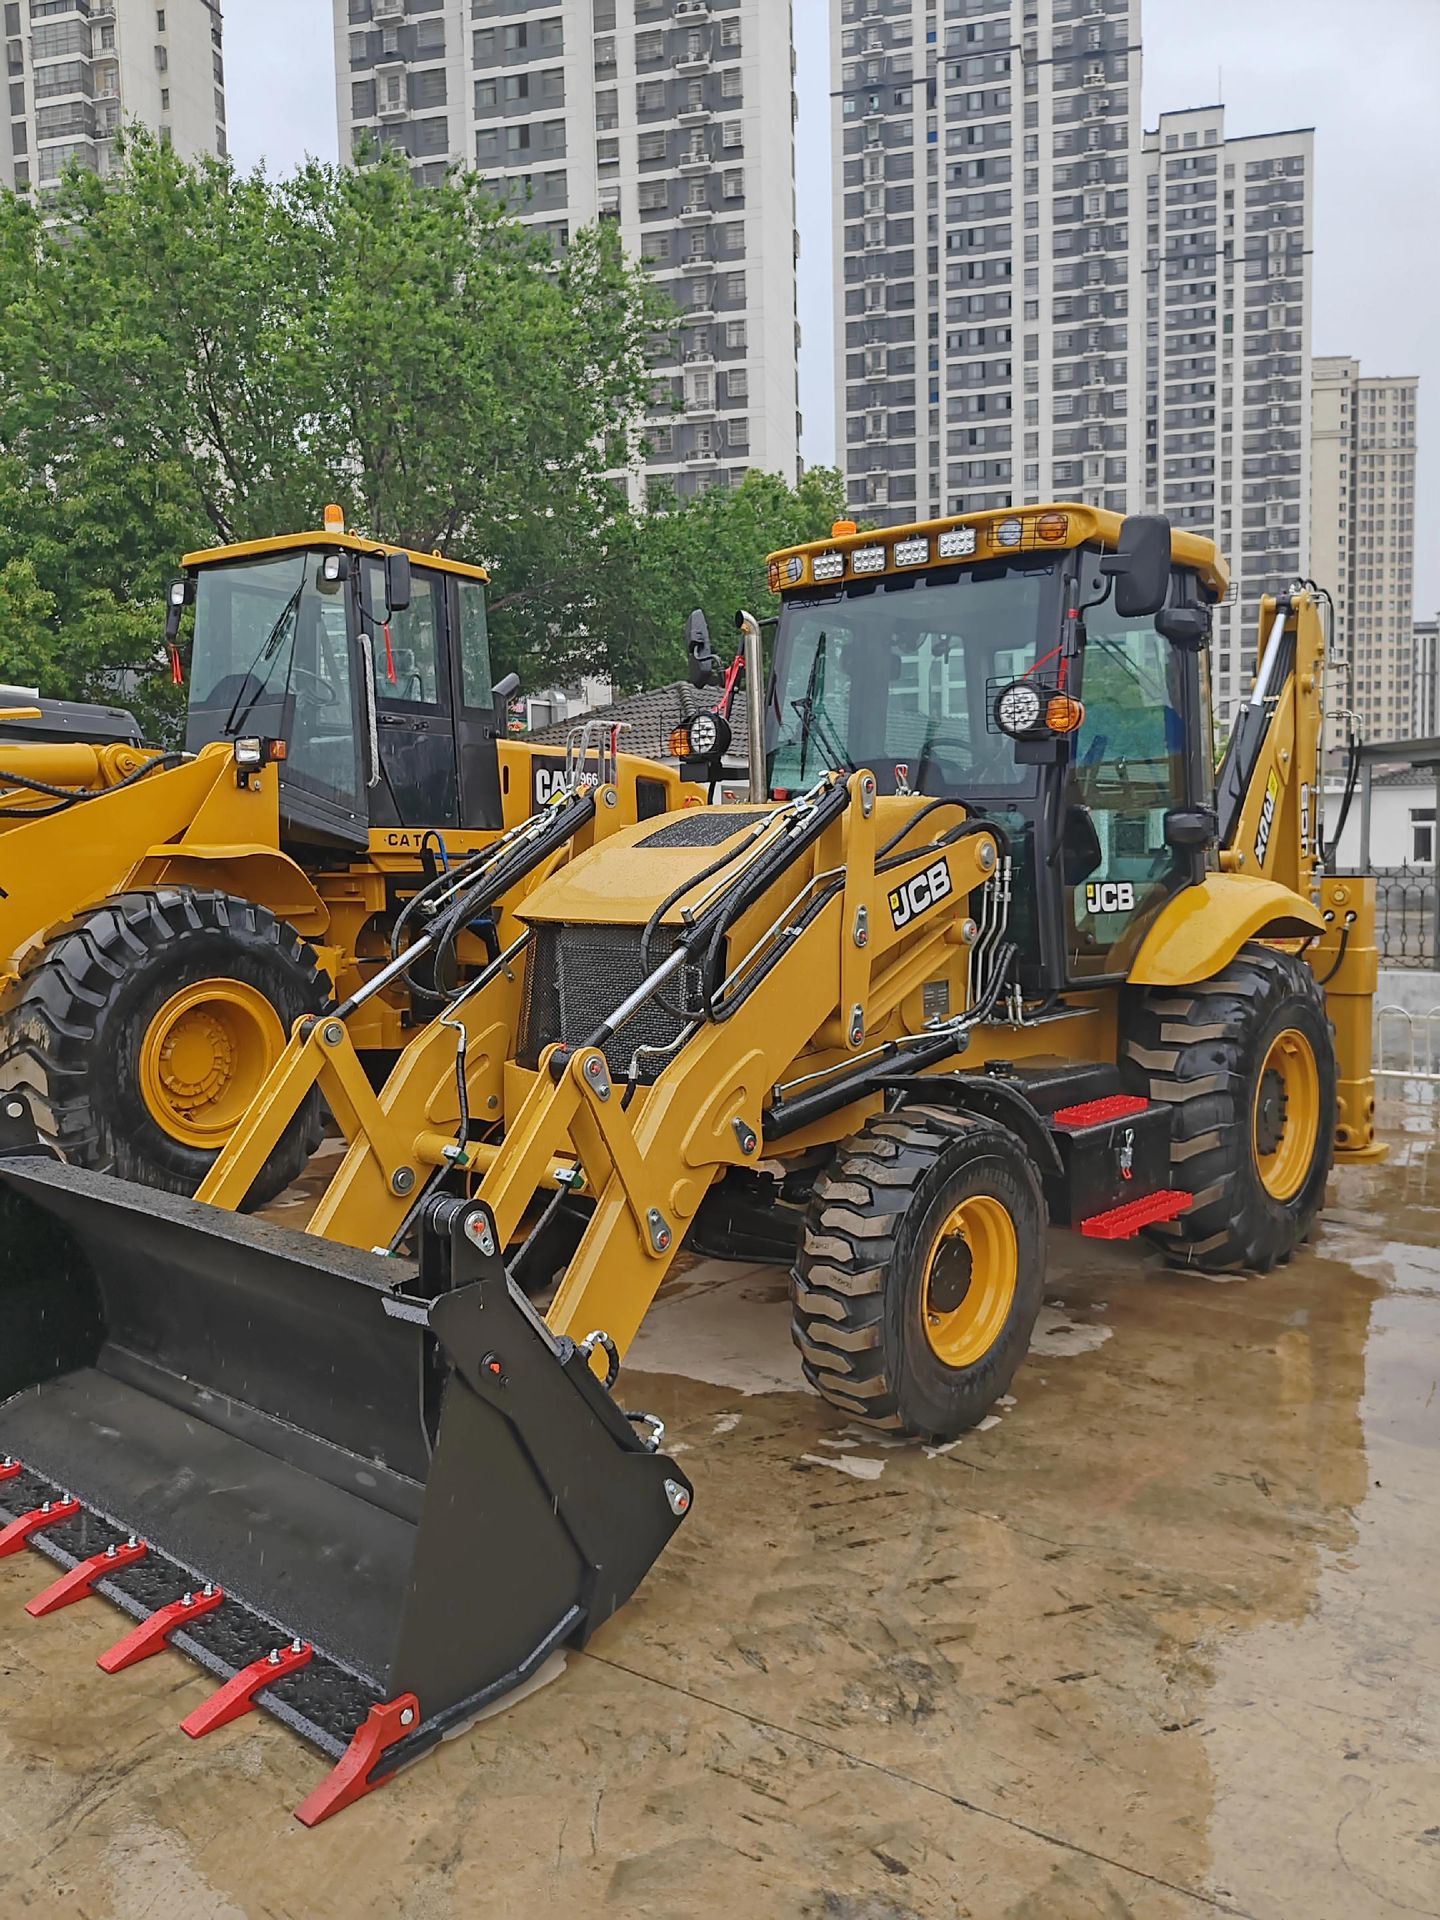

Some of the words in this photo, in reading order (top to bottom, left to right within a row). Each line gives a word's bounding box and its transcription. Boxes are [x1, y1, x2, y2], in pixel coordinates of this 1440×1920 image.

[580, 772, 599, 786] 966
[388, 833, 422, 847] CAT
[893, 861, 950, 926] JCB
[1086, 883, 1134, 913] JCB
